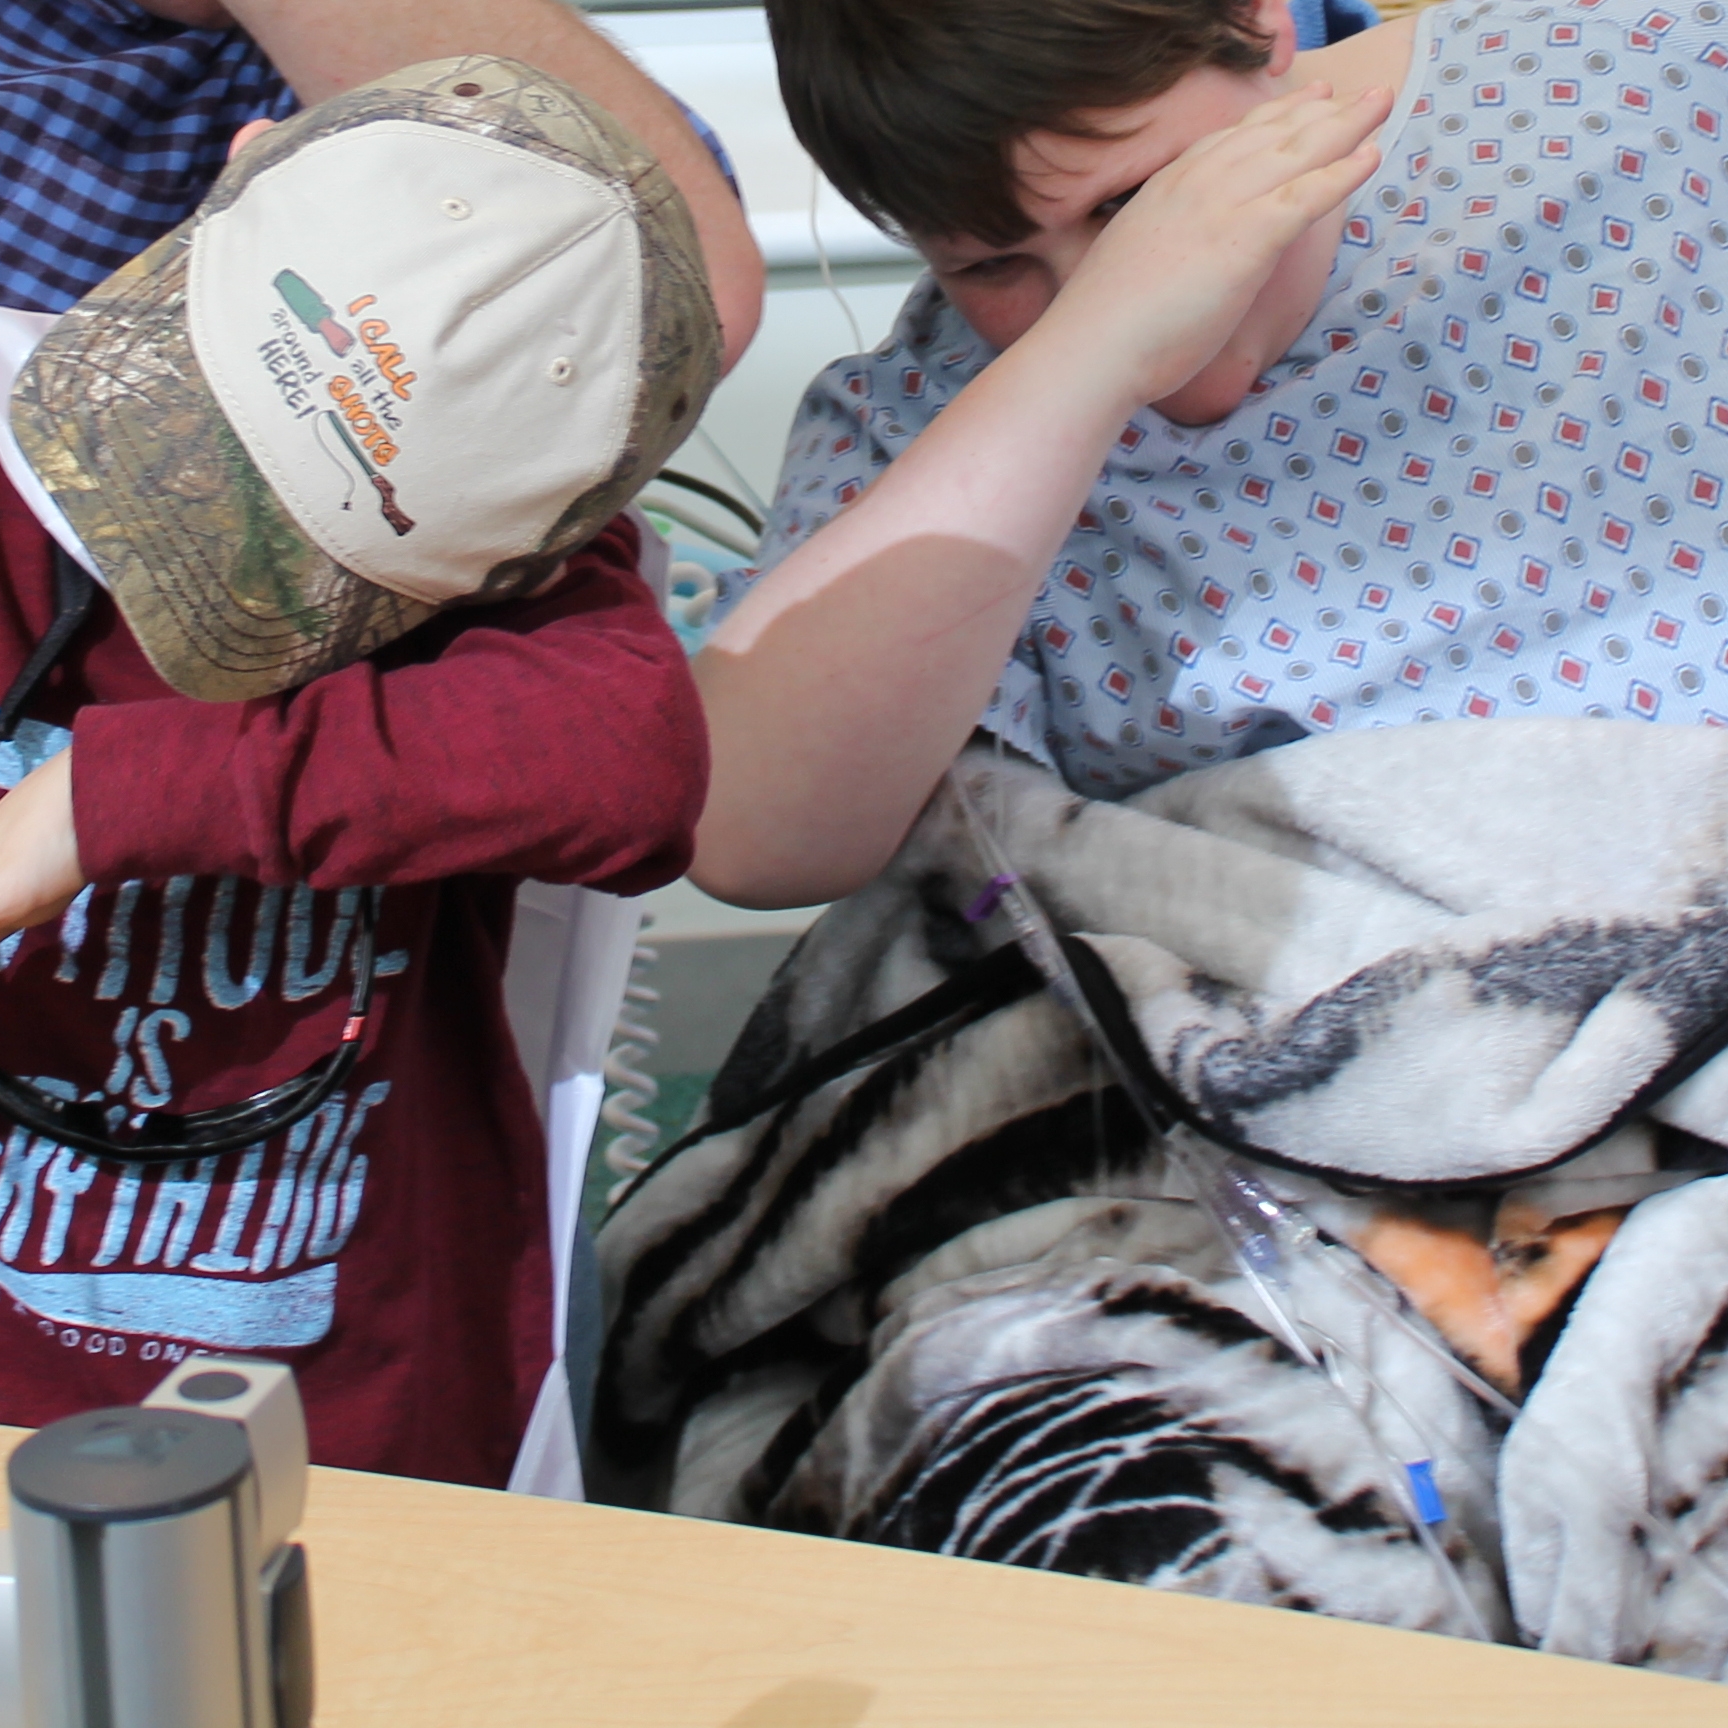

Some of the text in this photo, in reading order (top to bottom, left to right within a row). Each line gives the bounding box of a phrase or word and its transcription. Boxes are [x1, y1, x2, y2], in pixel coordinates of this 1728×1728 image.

[270, 307, 324, 384] around
[358, 318, 418, 402] CALL
[327, 375, 400, 467] SHOTS
[349, 358, 403, 431] all the
[105, 1006, 192, 1110] IS
[37, 1320, 128, 1357] GOOD
